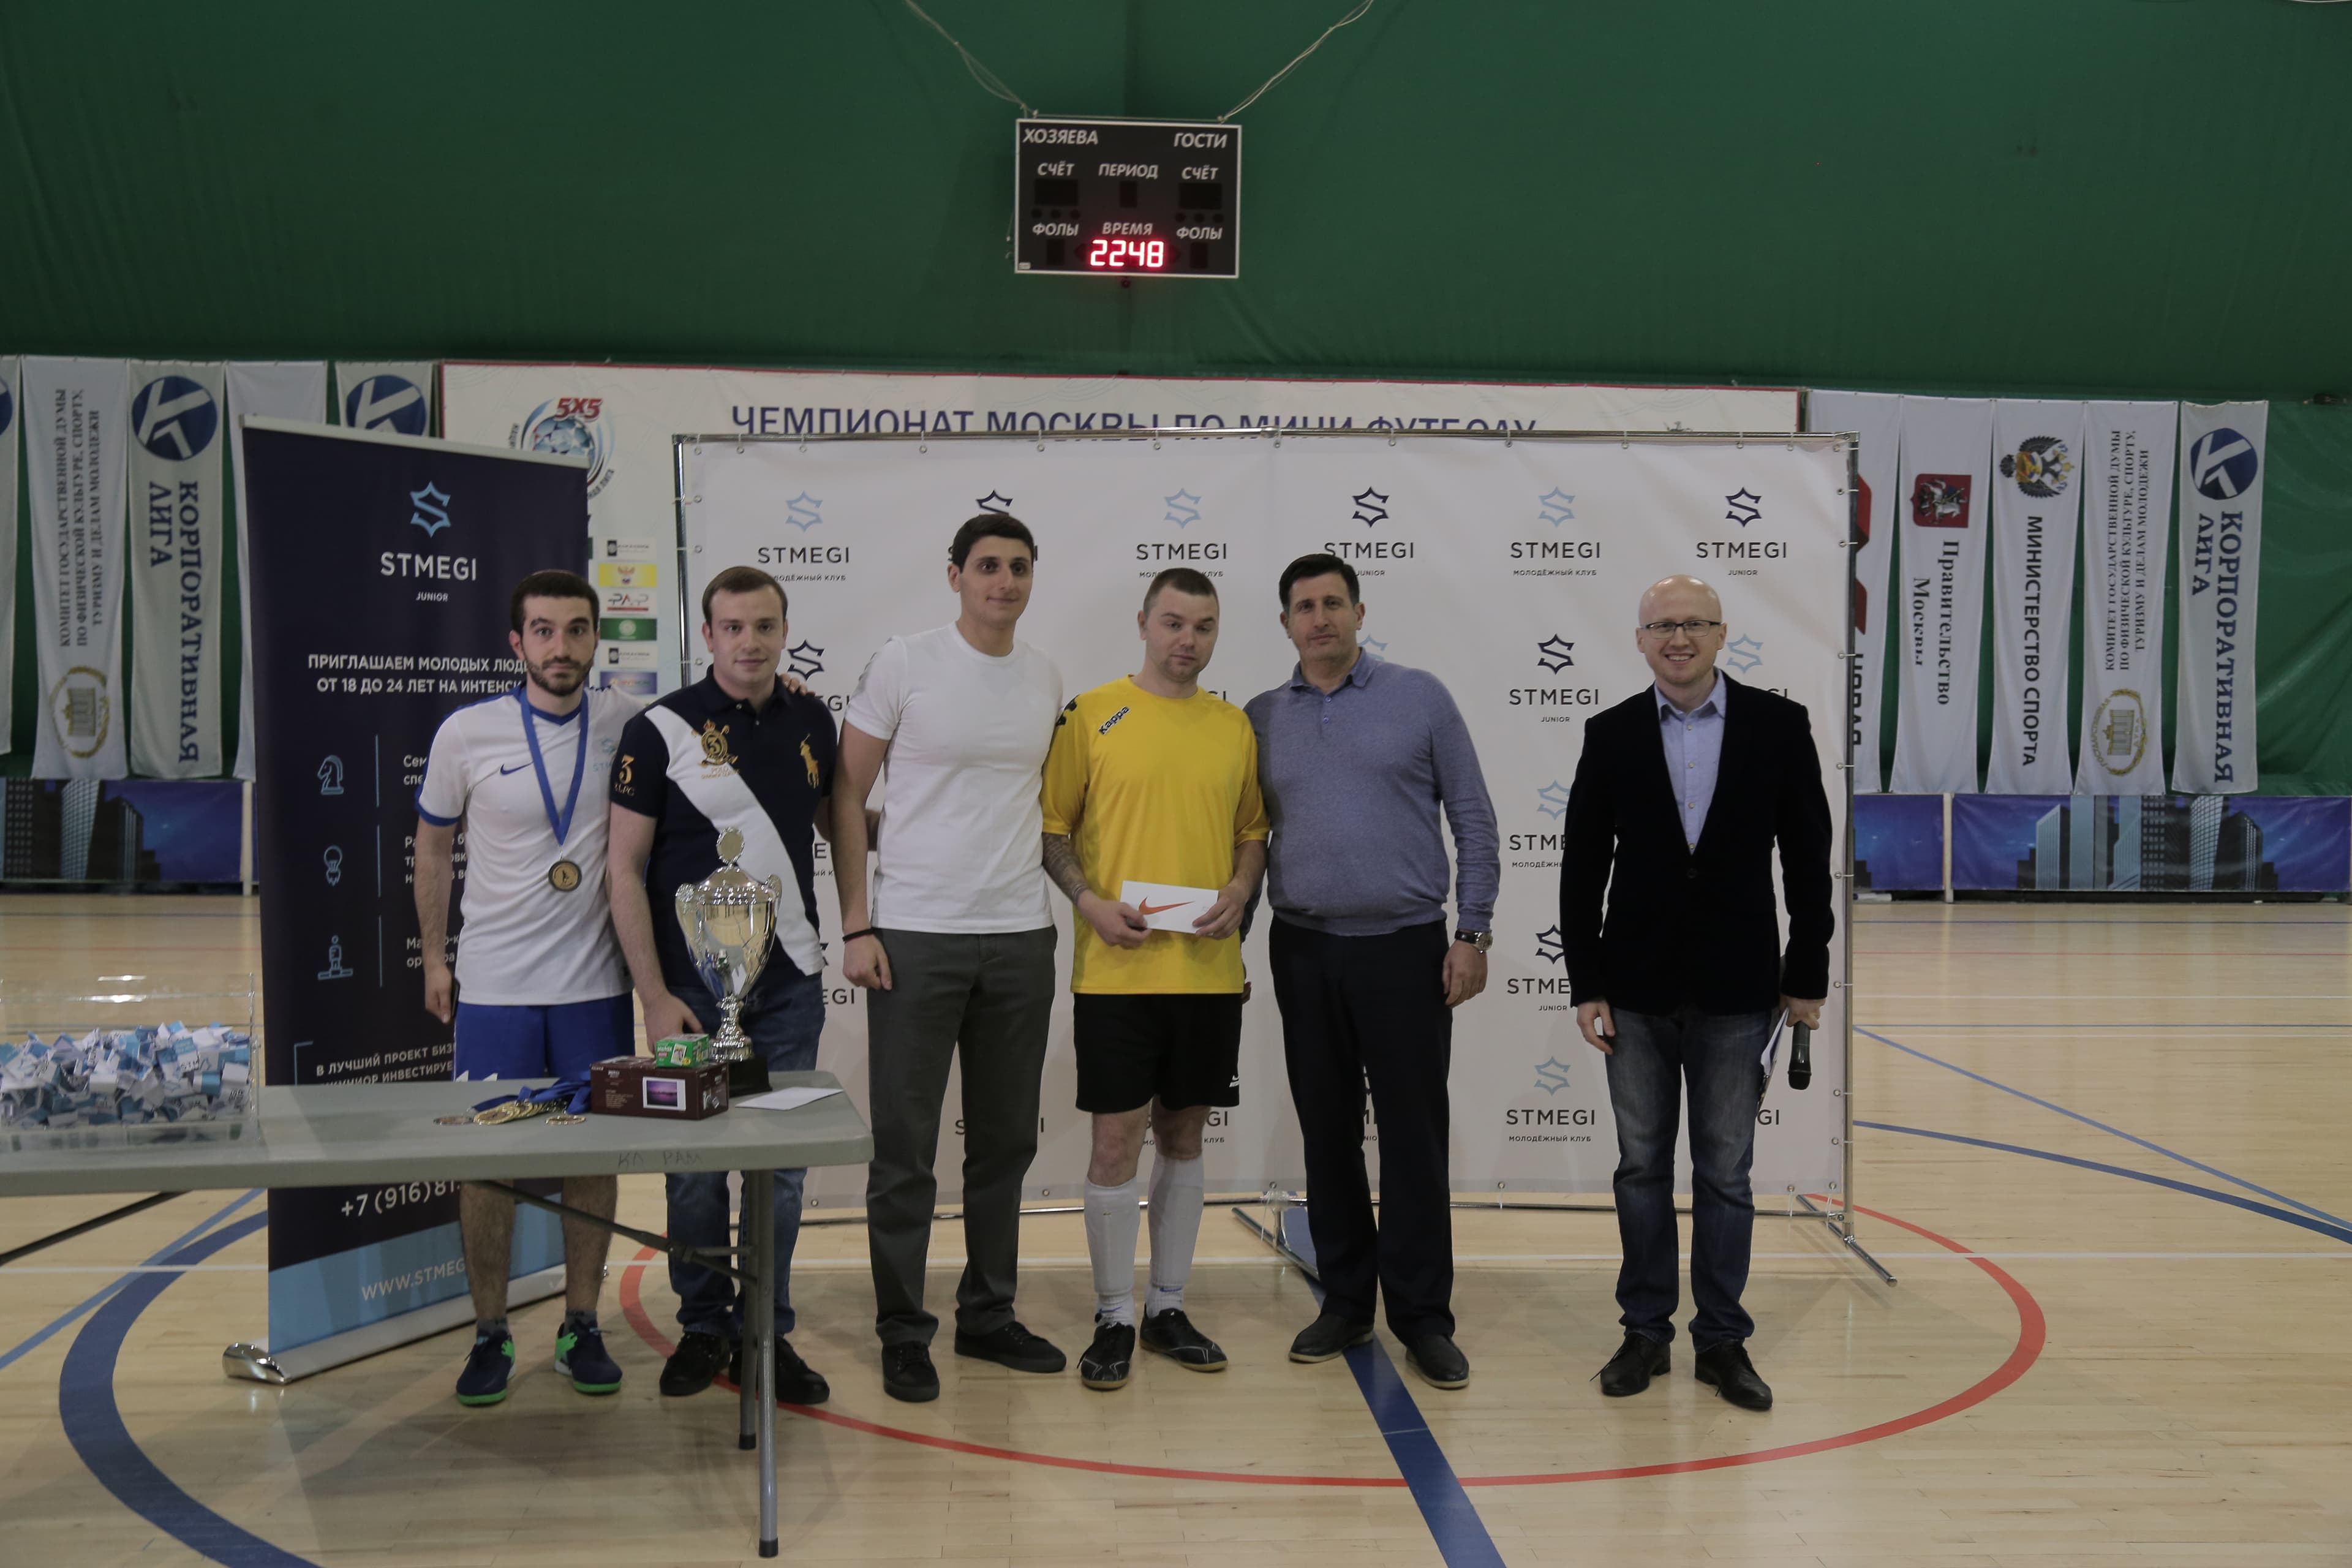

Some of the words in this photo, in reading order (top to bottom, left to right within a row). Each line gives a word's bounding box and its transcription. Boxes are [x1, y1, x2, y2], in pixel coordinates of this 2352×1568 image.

[1022, 129, 1099, 145] ХОЗЯЕВА
[1174, 133, 1227, 148] ГОСТИ
[1038, 161, 1074, 176] СЧЁТ
[1098, 164, 1158, 179] ПЕРИОД
[1182, 165, 1218, 180] СЧЁТ
[1033, 222, 1079, 236] ФОЛЫ
[1102, 222, 1153, 235] ВРЕМЯ
[1176, 227, 1223, 240] ФОЛЫ
[1090, 239, 1164, 267] 2248
[733, 405, 974, 434] ЧЕМПИОНАТ
[987, 411, 1158, 441] МОСКВЫ
[2109, 430, 2120, 472] ДУМЫ
[2123, 430, 2136, 484] СПОРТУ,
[2138, 450, 2149, 527] МОЛОДЕЖИ
[149, 481, 173, 568] ЛИГА
[2122, 487, 2134, 556] КУЛЬТУРЕ,
[1136, 543, 1227, 560] STMEGI
[1324, 542, 1414, 559] STMEGI
[1510, 542, 1600, 559] STMEGI
[1696, 541, 1786, 559] STMEGI
[2106, 475, 2119, 604] ГОСУДАРСТВЕННОЙ
[2136, 530, 2147, 577] ДЕЛАМ
[380, 551, 477, 581] STMEGI
[757, 546, 850, 564] STMEGI
[2192, 513, 2214, 597] ЛИГА
[416, 591, 449, 602] JUNIOR
[2136, 579, 2146, 588] И
[2023, 516, 2043, 682] МИНИСТЕРСТВО
[2119, 559, 2131, 649] ФИЗИЧЕСКОЙ
[178, 480, 202, 763] КОРПОРАТИВНАЯ
[1912, 578, 1931, 666] Москвы
[1937, 540, 1959, 706] Правительство
[2135, 591, 2145, 652] ТУРИЗМУ
[2105, 605, 2116, 671] КОМИТЕТ
[2214, 510, 2243, 783] КОРПОРАТИВНАЯ
[307, 654, 414, 671] ПРИГЛАШАЕМ
[418, 656, 490, 673] МОЛОДЫХ
[2119, 652, 2130, 671] ПО
[317, 677, 337, 692] ОТ
[342, 677, 357, 692] 18
[360, 678, 383, 695] ДО
[386, 678, 404, 693] 24
[407, 679, 435, 693] ЛЕТ
[439, 680, 458, 693] НА
[1509, 688, 1599, 705] STMEGI
[1098, 706, 1131, 734] Kappa
[2022, 687, 2040, 767] СПОРТА
[619, 754, 635, 785] 3
[1507, 978, 1570, 994] STME
[316, 1065, 324, 1076] В
[328, 1053, 380, 1074] ЛУЧШИЙ
[384, 1047, 428, 1065] ПРОЕКТ
[432, 1042, 455, 1056] БИЗ
[1506, 1109, 1594, 1125] STMEGI
